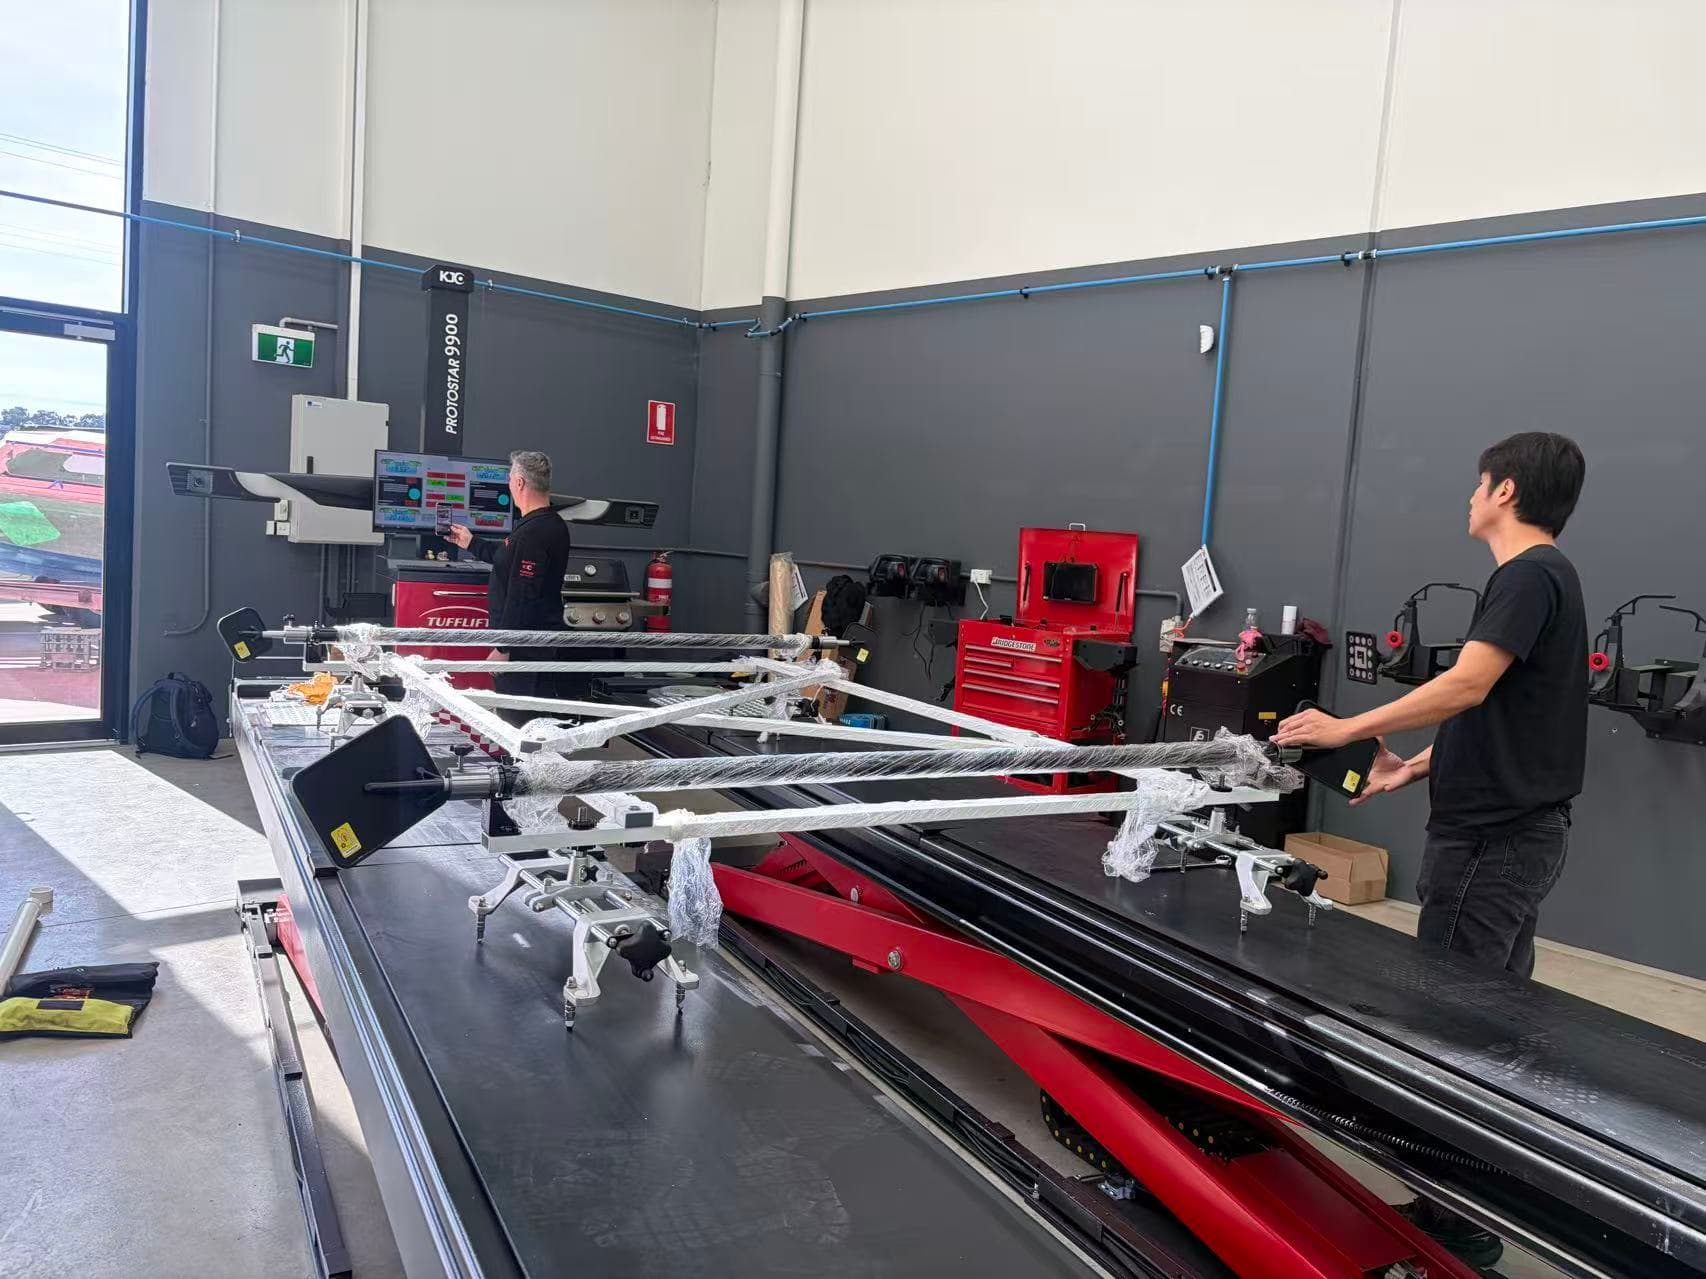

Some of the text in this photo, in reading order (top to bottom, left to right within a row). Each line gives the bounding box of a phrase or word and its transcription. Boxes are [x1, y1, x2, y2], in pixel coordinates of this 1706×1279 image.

[444, 313, 461, 434] PROTOSTAR 9900
[427, 616, 489, 628] TUFFLIFT
[992, 637, 1035, 651] BRIDGESTONE
